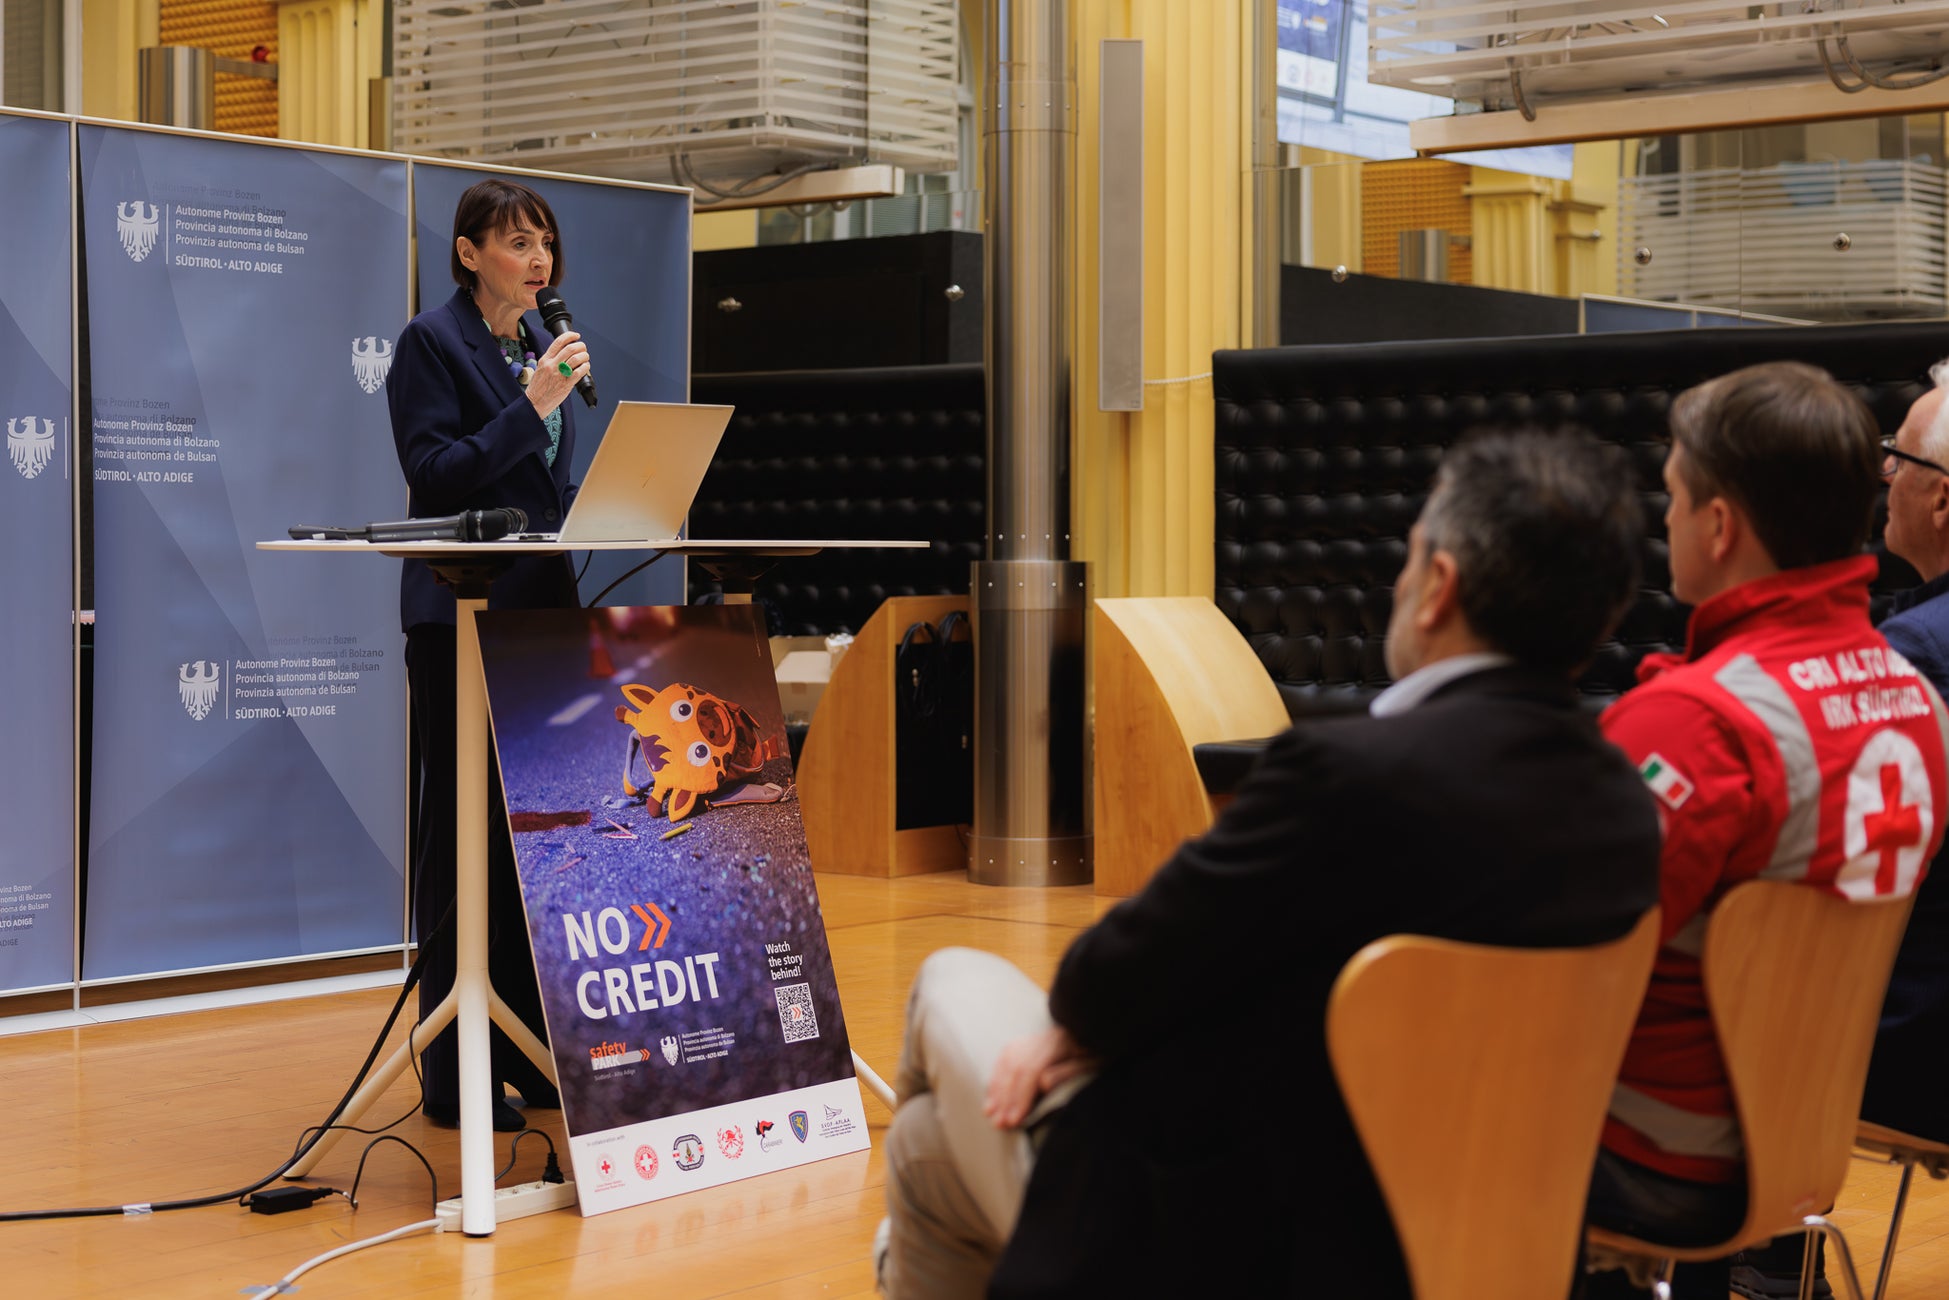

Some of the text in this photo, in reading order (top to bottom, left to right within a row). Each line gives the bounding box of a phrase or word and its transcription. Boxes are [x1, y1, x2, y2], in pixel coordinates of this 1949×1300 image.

[175, 204, 222, 218] Autonome
[224, 209, 255, 222] Provinz
[257, 212, 284, 224] Bozen
[175, 220, 216, 233] Provincia
[218, 224, 262, 237] autonoma
[264, 226, 273, 238] di
[274, 228, 309, 241] Bolzano
[175, 234, 305, 255] Provinzia autonoma de Bulsan
[175, 254, 284, 274] SÜDTIROL ALTO ADIGE
[94, 418, 194, 432] Autonome Provinz Bozen
[94, 433, 220, 448] Provincia autonoma di Bolzano
[94, 448, 124, 460] Provinzia
[126, 450, 171, 461] autonoma
[174, 450, 184, 461] de
[187, 451, 217, 462] Bulsan
[136, 472, 161, 482] ALTO
[163, 472, 194, 483] ADIGE
[348, 648, 384, 658] Bolzano
[235, 659, 279, 670] Autonome
[280, 658, 310, 668] Provinz
[312, 657, 336, 667] Bozen
[1787, 655, 1838, 691] CRI
[1835, 646, 1886, 684] ALTO
[235, 670, 360, 684] Provincia autonoma di Bolzano
[235, 688, 274, 698] Provinzia
[276, 686, 317, 697] autonoma
[318, 685, 329, 695] de
[330, 684, 357, 694] Bulsan
[235, 705, 336, 720] SÜDTIROL ALTO ADIGE
[13, 884, 32, 892] Bozen
[18, 894, 25, 902] di
[26, 892, 52, 901] Bolzano
[19, 904, 27, 912] de
[28, 902, 49, 910] Bulsan
[0, 919, 12, 928] LTO
[12, 918, 33, 926] ADIGE
[562, 906, 631, 961] NO
[764, 940, 791, 955] Watch
[768, 954, 803, 968] the story
[770, 966, 802, 981] behind!
[576, 952, 720, 1020] CREDIT
[589, 1040, 628, 1060] safety
[592, 1055, 621, 1070] PARK
